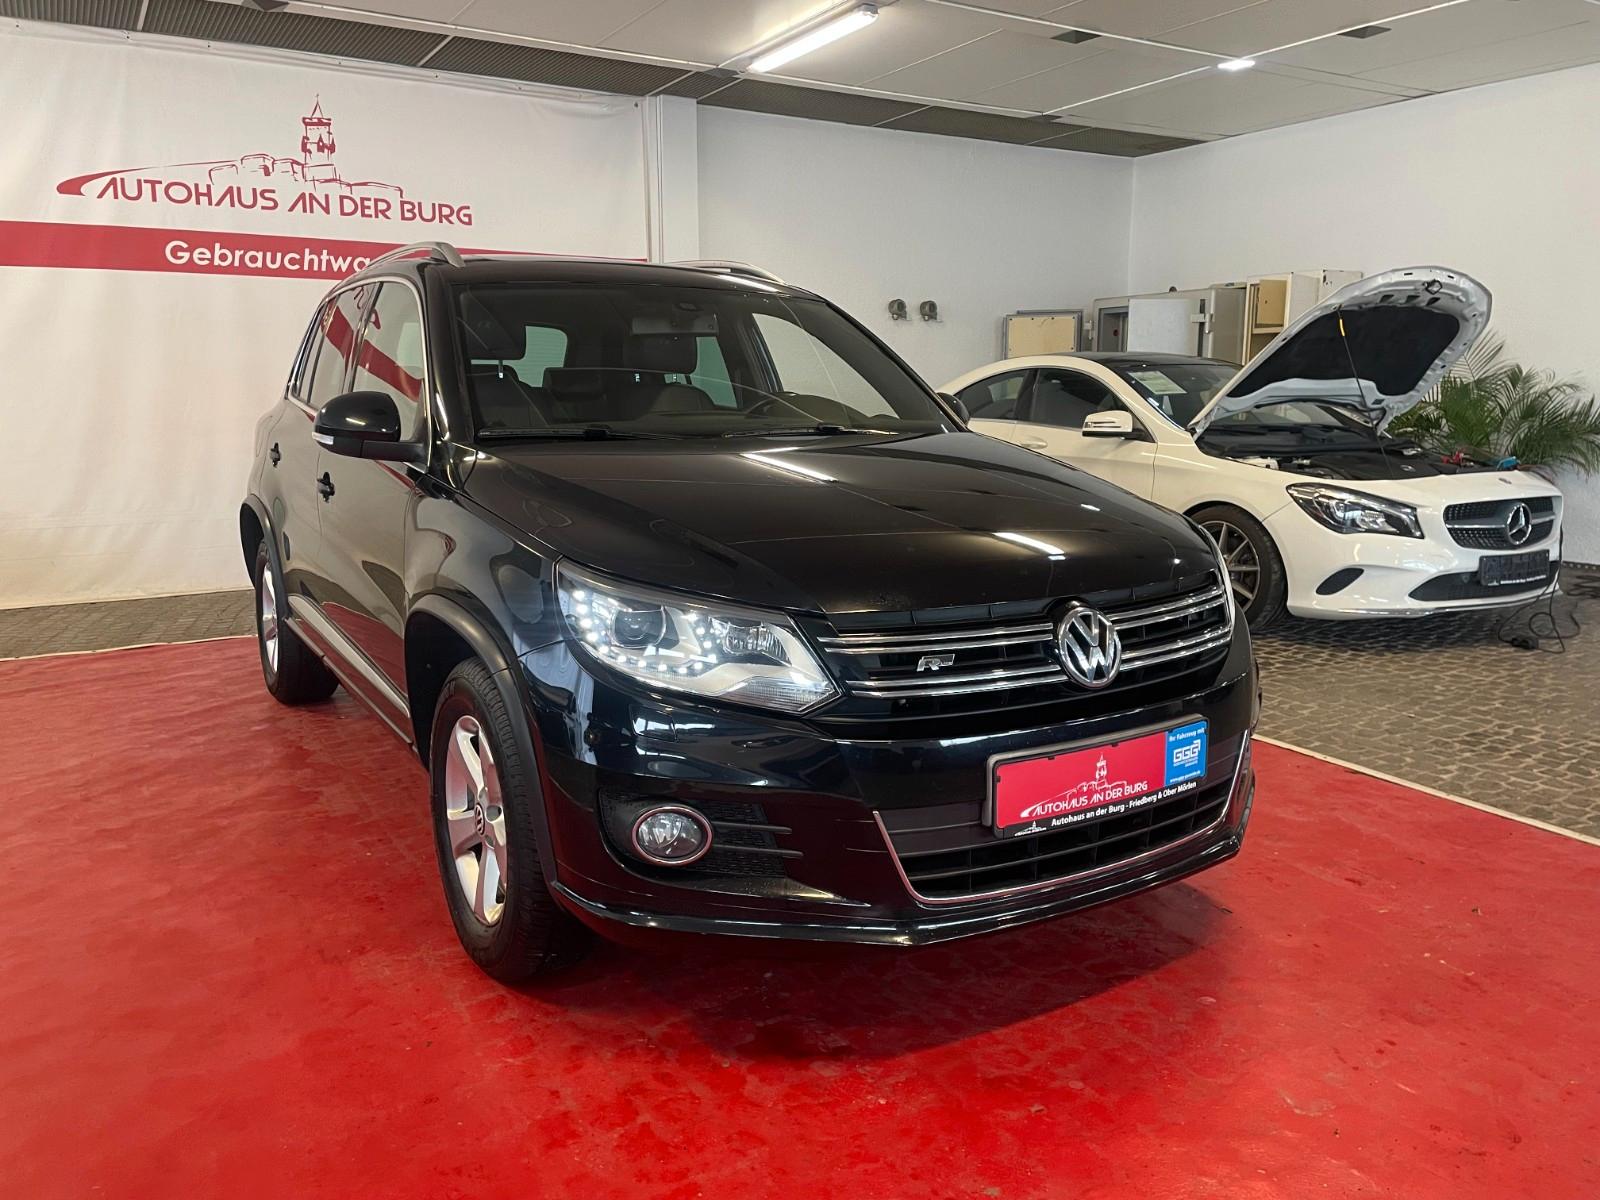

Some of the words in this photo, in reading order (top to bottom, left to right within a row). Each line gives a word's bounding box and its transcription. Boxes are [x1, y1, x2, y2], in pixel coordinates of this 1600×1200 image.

[96, 176, 279, 212] AUTOHAUS
[287, 191, 331, 215] AN
[339, 195, 391, 220] DER
[400, 200, 473, 227] BURG
[1032, 795, 1088, 816] AUTOHAUS
[1089, 791, 1104, 805] AN
[1105, 787, 1123, 802] DER
[1124, 781, 1148, 797] BURG
[1051, 813, 1085, 826] Autohaus
[1085, 811, 1095, 819] an
[1095, 807, 1108, 817] der
[1108, 803, 1125, 814] Burg
[1129, 794, 1157, 808] Friedberg
[1162, 786, 1178, 798] Ober
